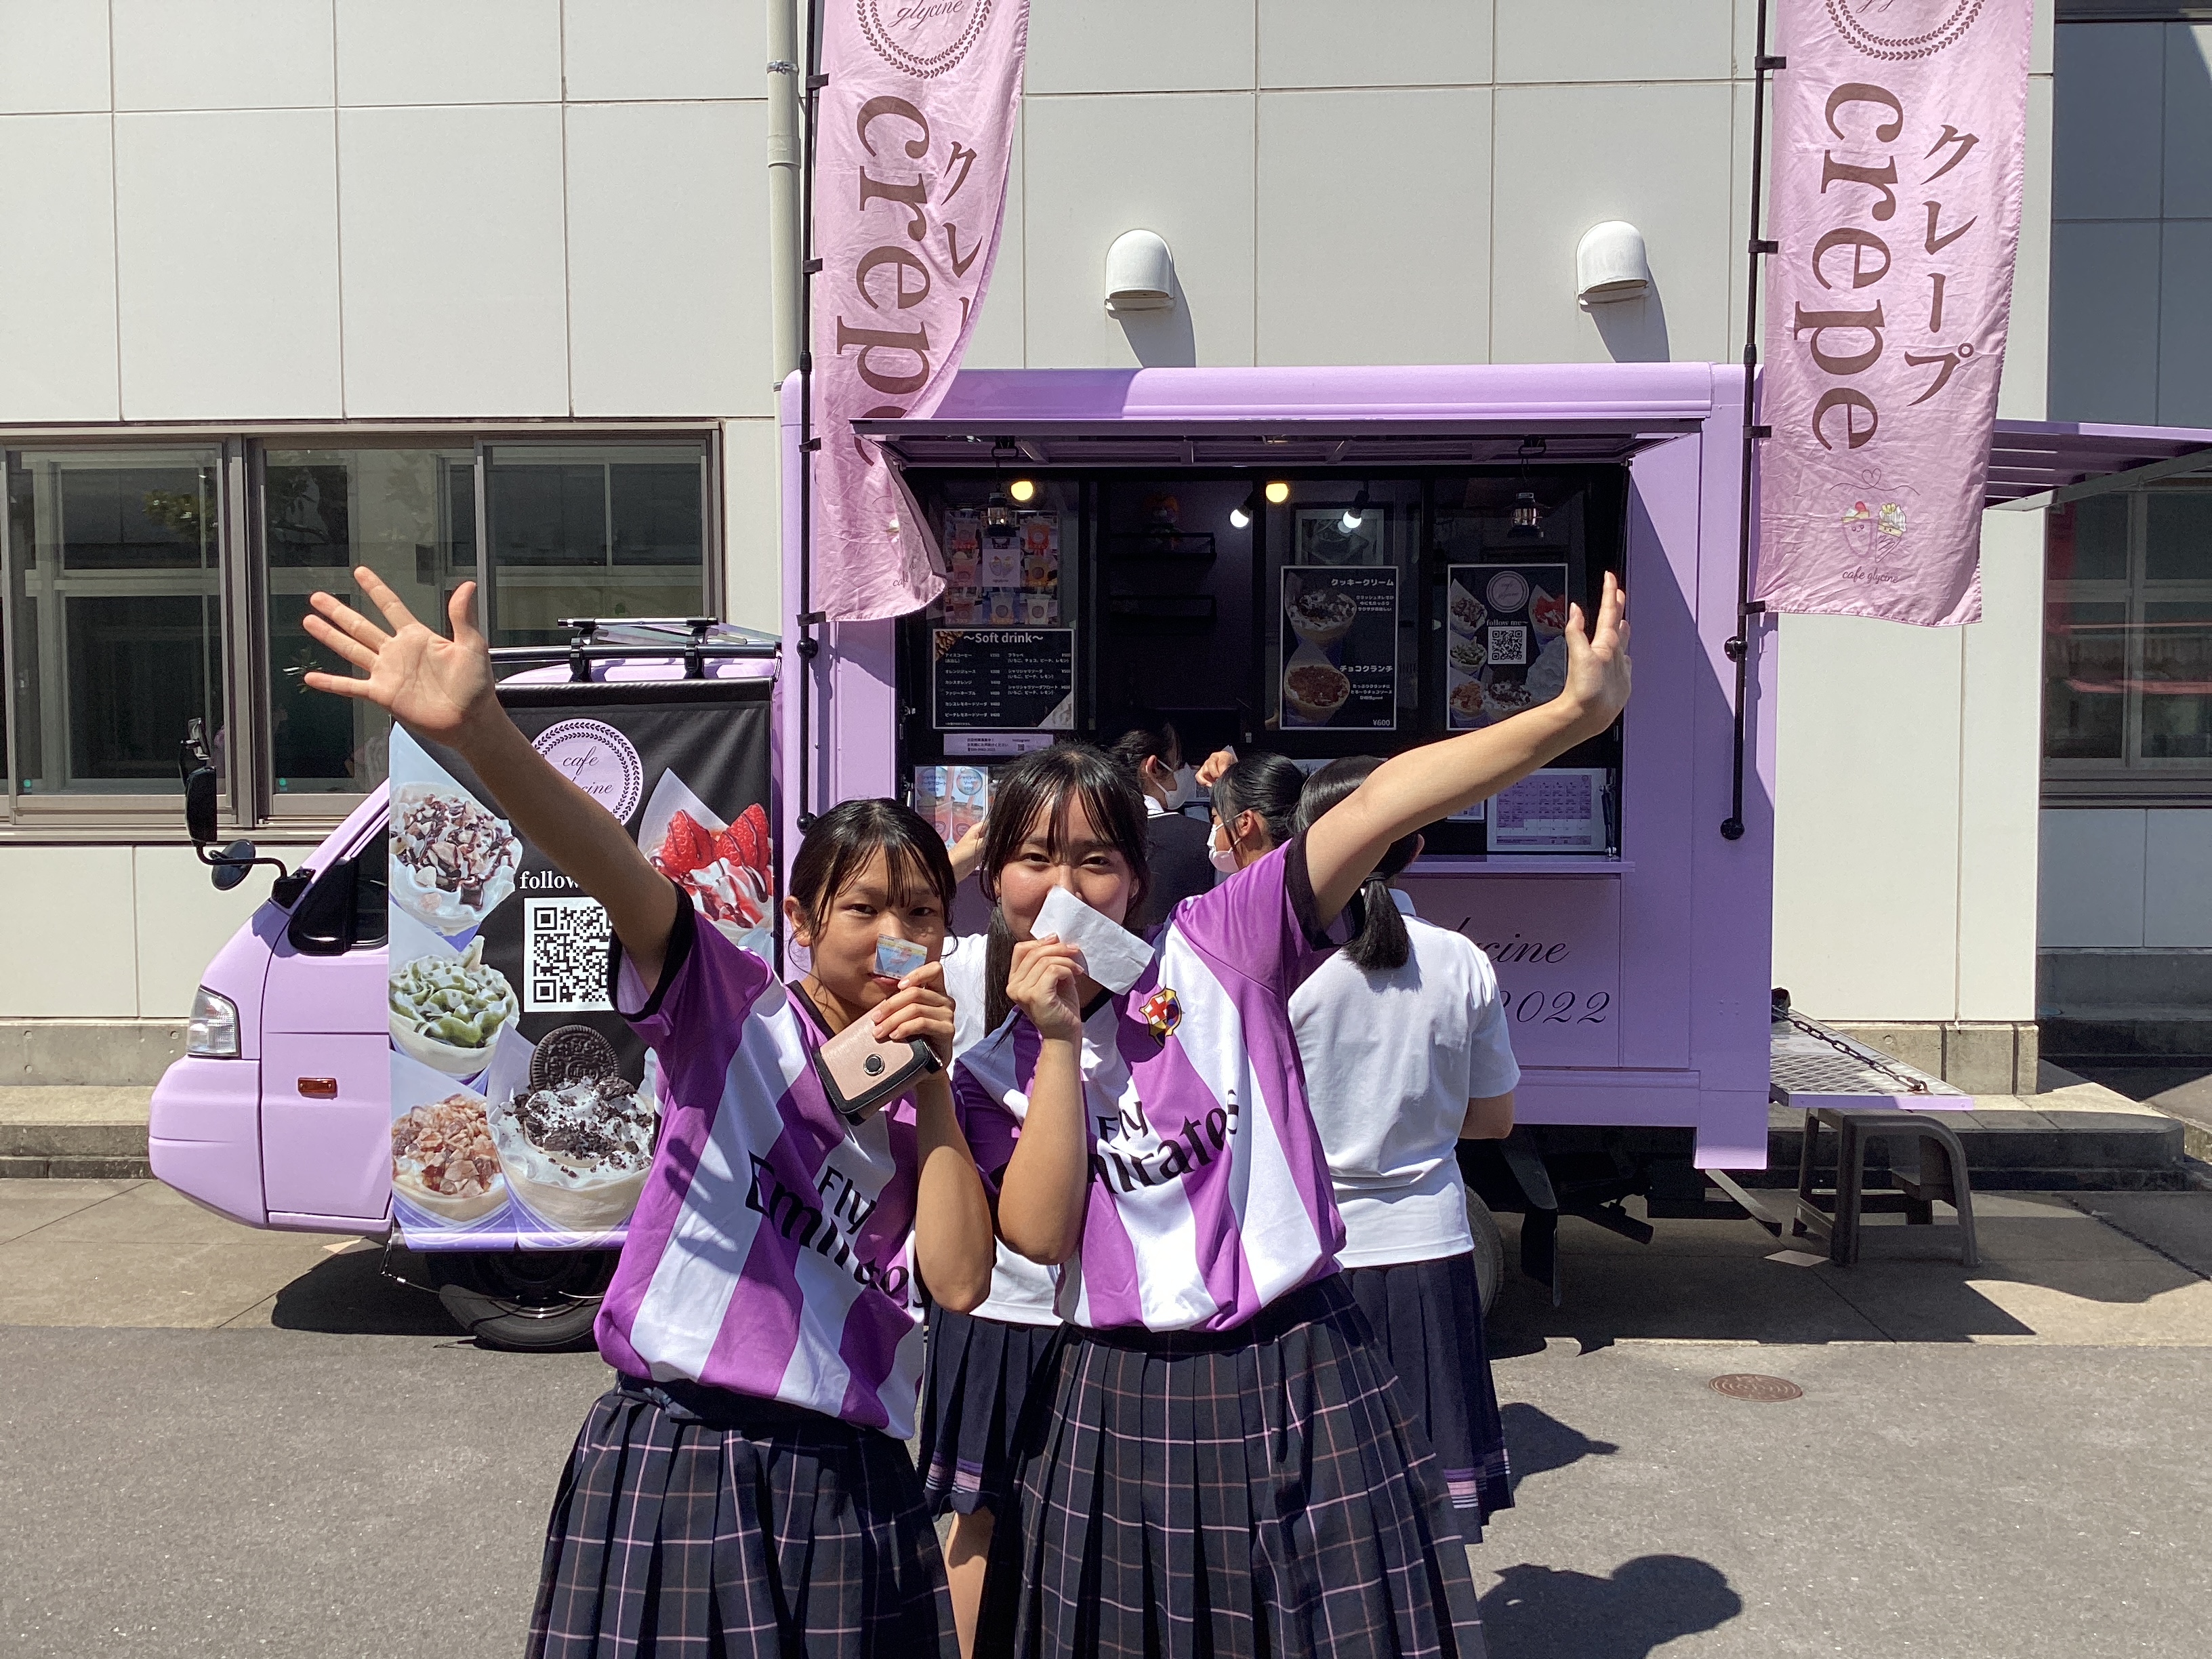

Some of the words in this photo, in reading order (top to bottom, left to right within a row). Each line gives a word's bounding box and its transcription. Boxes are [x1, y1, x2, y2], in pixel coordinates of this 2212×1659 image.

[1794, 82, 1904, 451] crepe
[1904, 124, 1980, 407] クレープ
[1842, 566, 1865, 583] cafe
[562, 745, 600, 776] cafe
[1097, 1101, 1149, 1141] Fly
[818, 1165, 878, 1235] Fly
